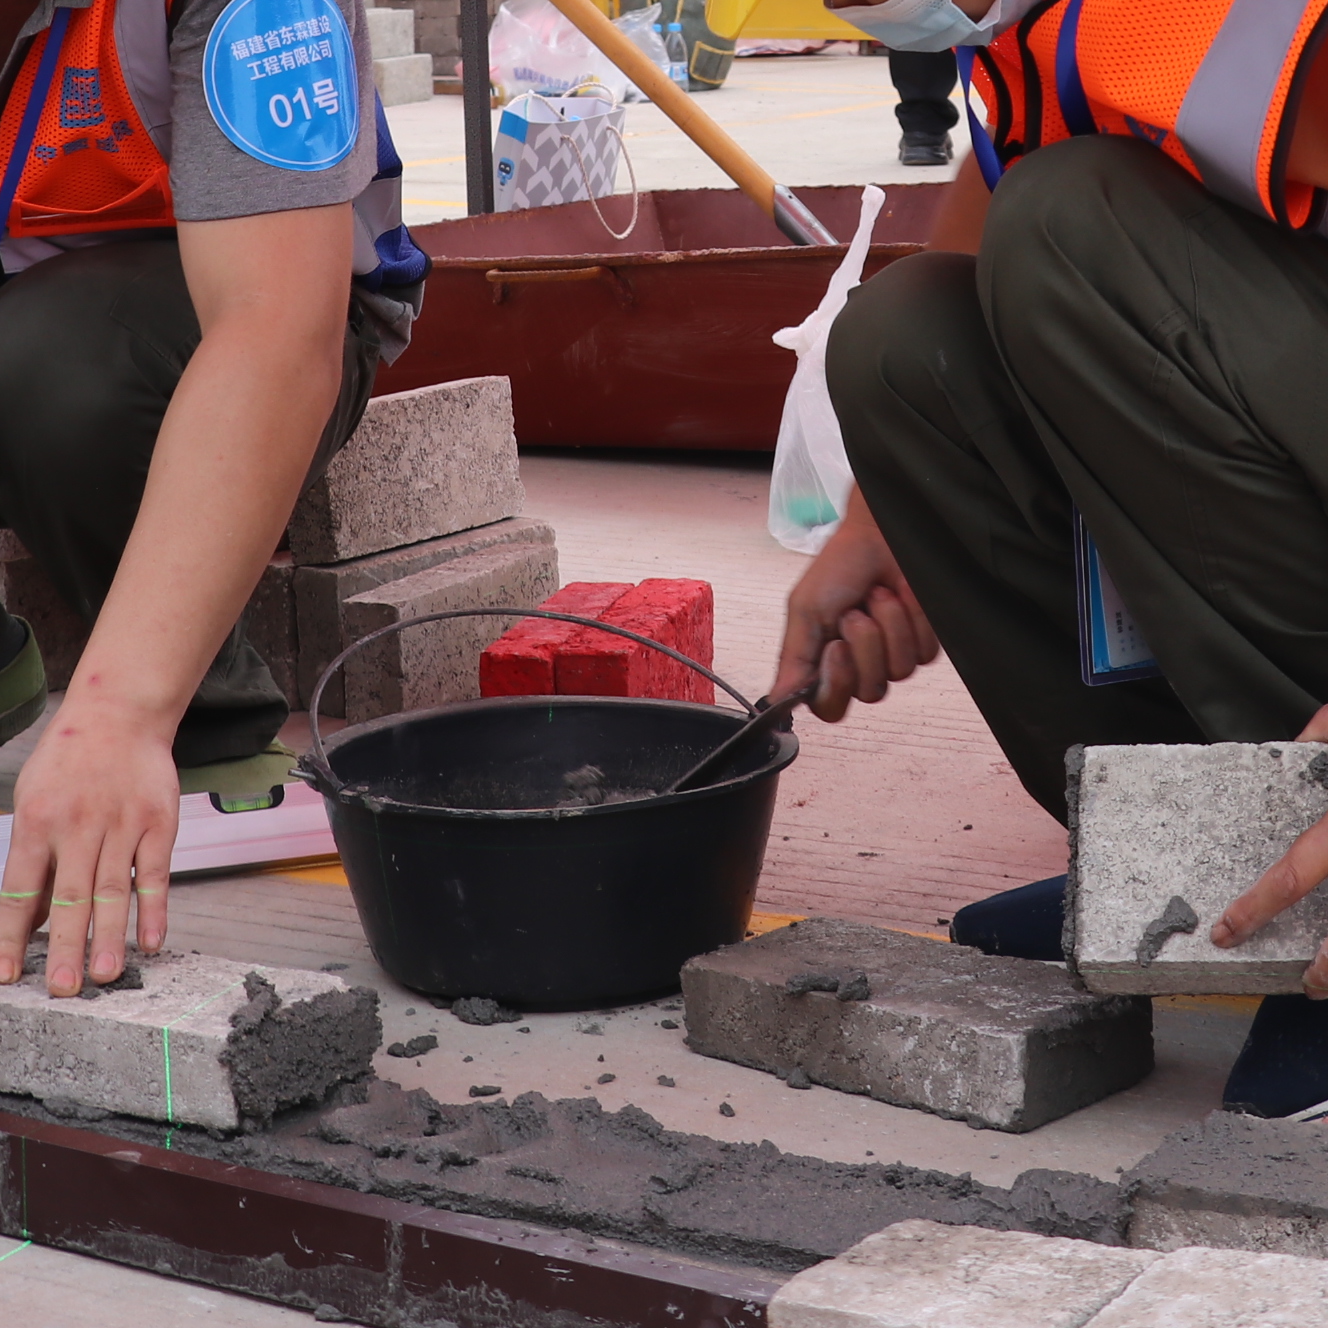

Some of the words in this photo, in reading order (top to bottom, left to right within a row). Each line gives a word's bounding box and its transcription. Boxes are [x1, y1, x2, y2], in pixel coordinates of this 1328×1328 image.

[230, 15, 332, 61] 福建省东霖建设
[247, 39, 333, 81] 工程有限公司
[268, 78, 339, 128] 01号
